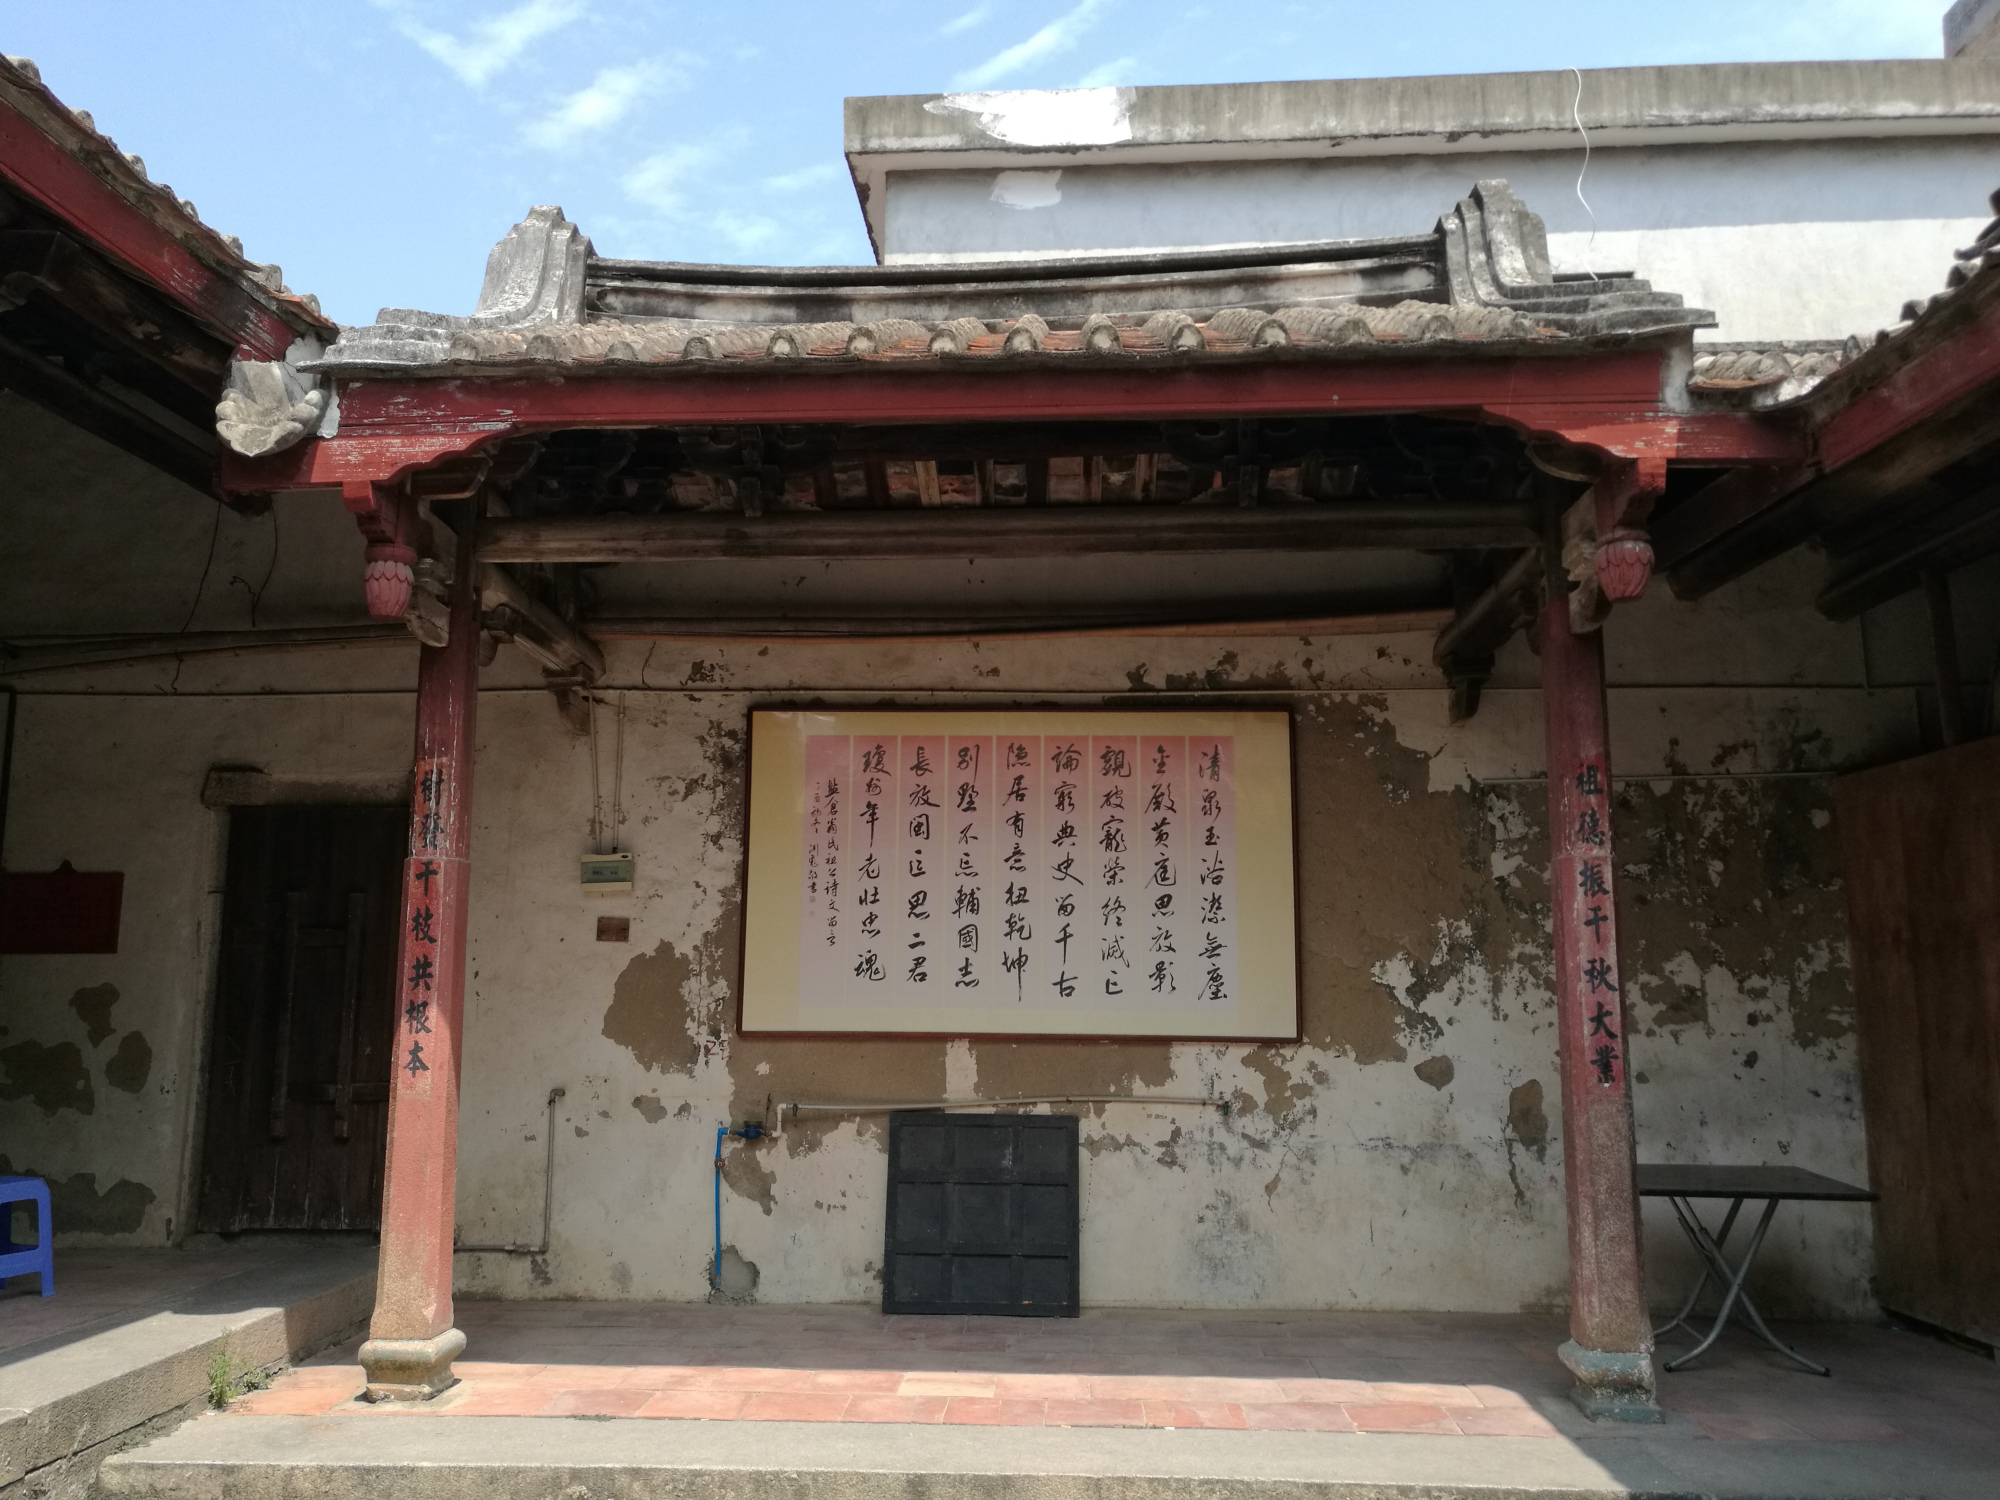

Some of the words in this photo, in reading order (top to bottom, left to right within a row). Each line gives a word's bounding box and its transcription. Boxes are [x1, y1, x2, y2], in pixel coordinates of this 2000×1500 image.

[1575, 763, 1619, 1083] 祖德振千秋大業
